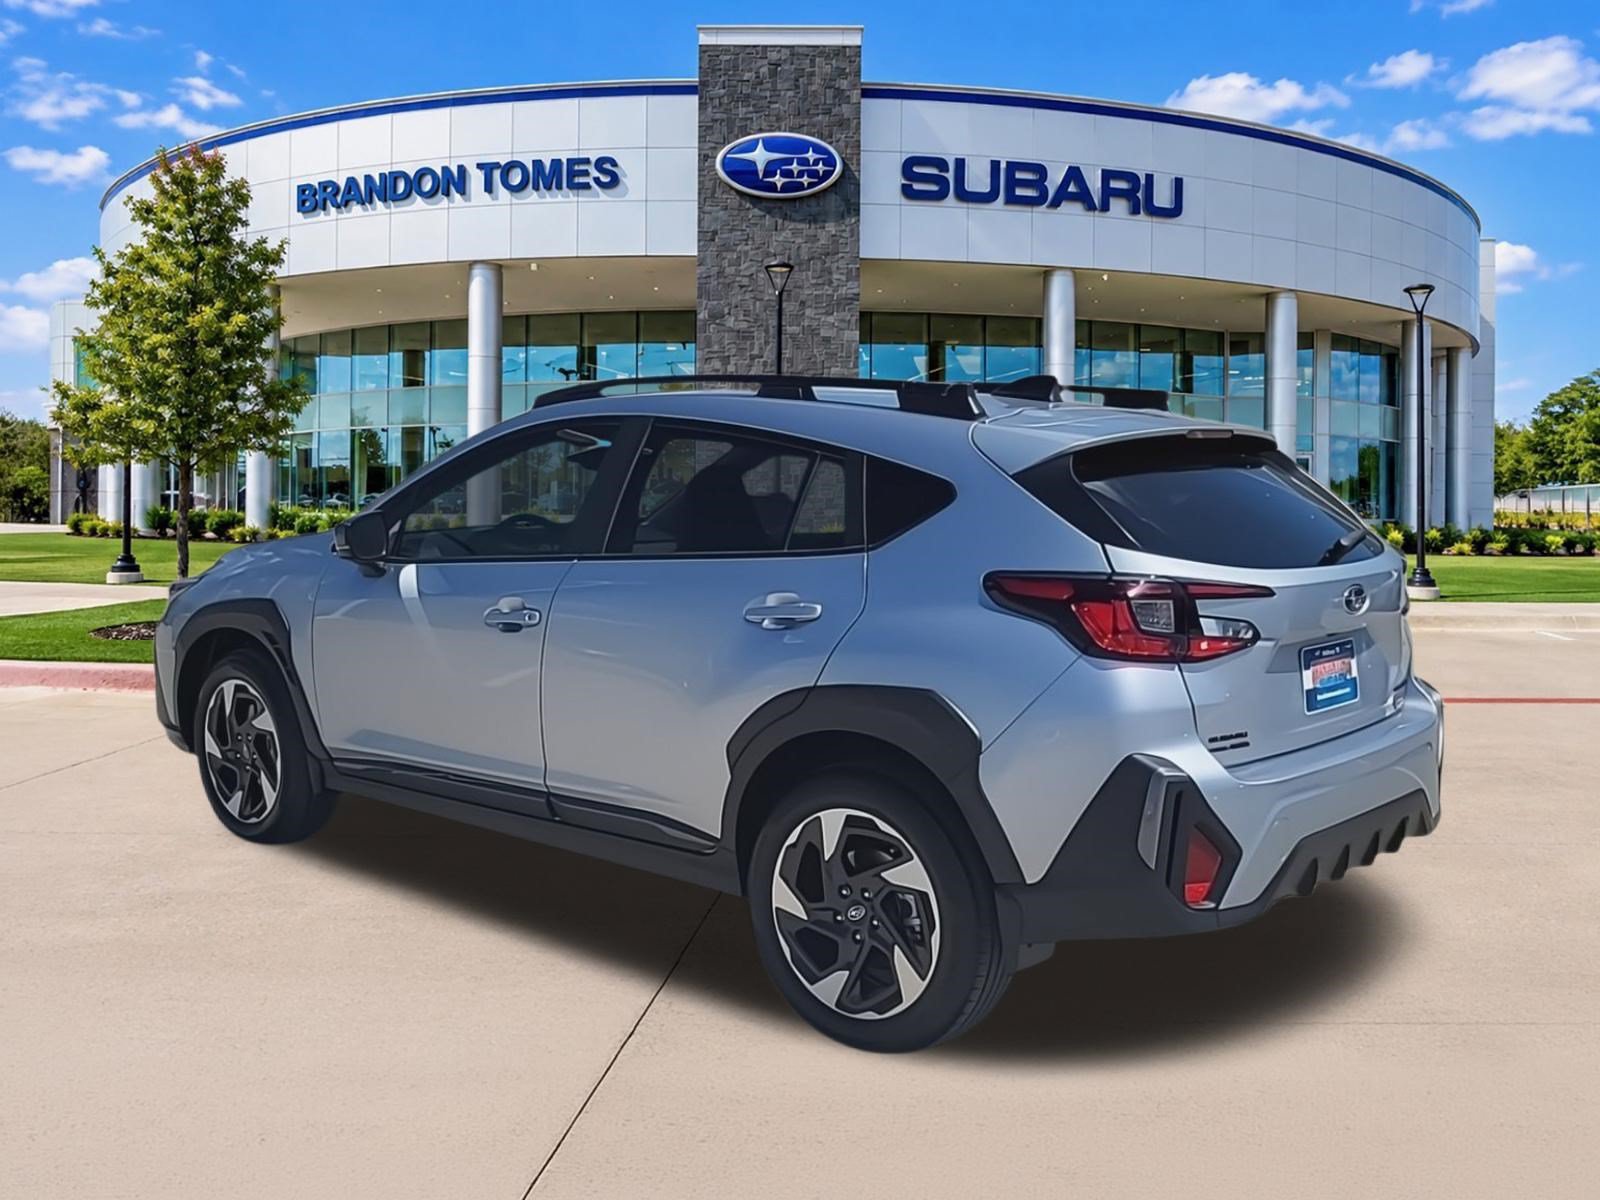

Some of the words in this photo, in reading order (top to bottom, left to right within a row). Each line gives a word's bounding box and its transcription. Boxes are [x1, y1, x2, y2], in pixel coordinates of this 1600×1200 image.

[297, 164, 467, 213] BRANDON
[476, 156, 620, 194] TOMES
[901, 156, 1184, 218] SUBARU
